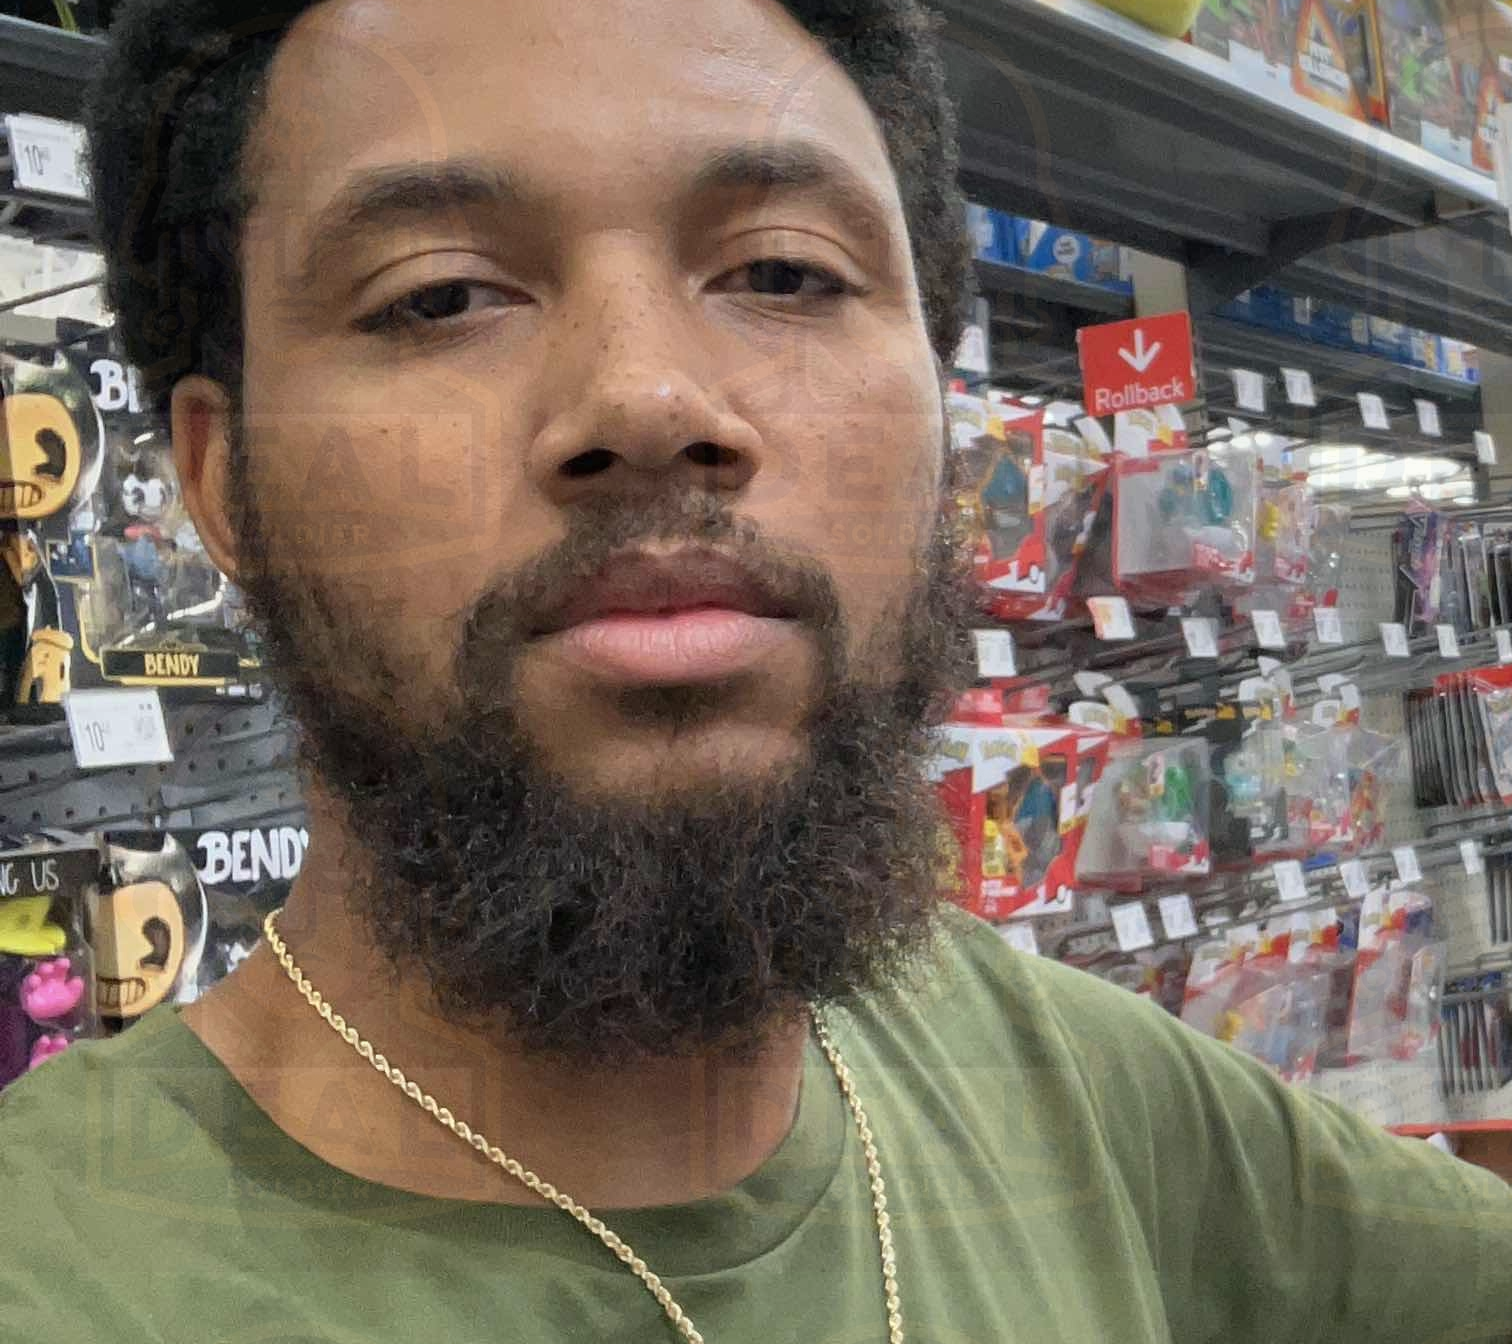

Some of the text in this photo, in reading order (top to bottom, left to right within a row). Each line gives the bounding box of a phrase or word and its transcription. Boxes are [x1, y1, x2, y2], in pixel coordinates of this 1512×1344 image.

[1094, 377, 1185, 412] Rollback
[143, 652, 200, 676] BENDY
[31, 858, 60, 892] US
